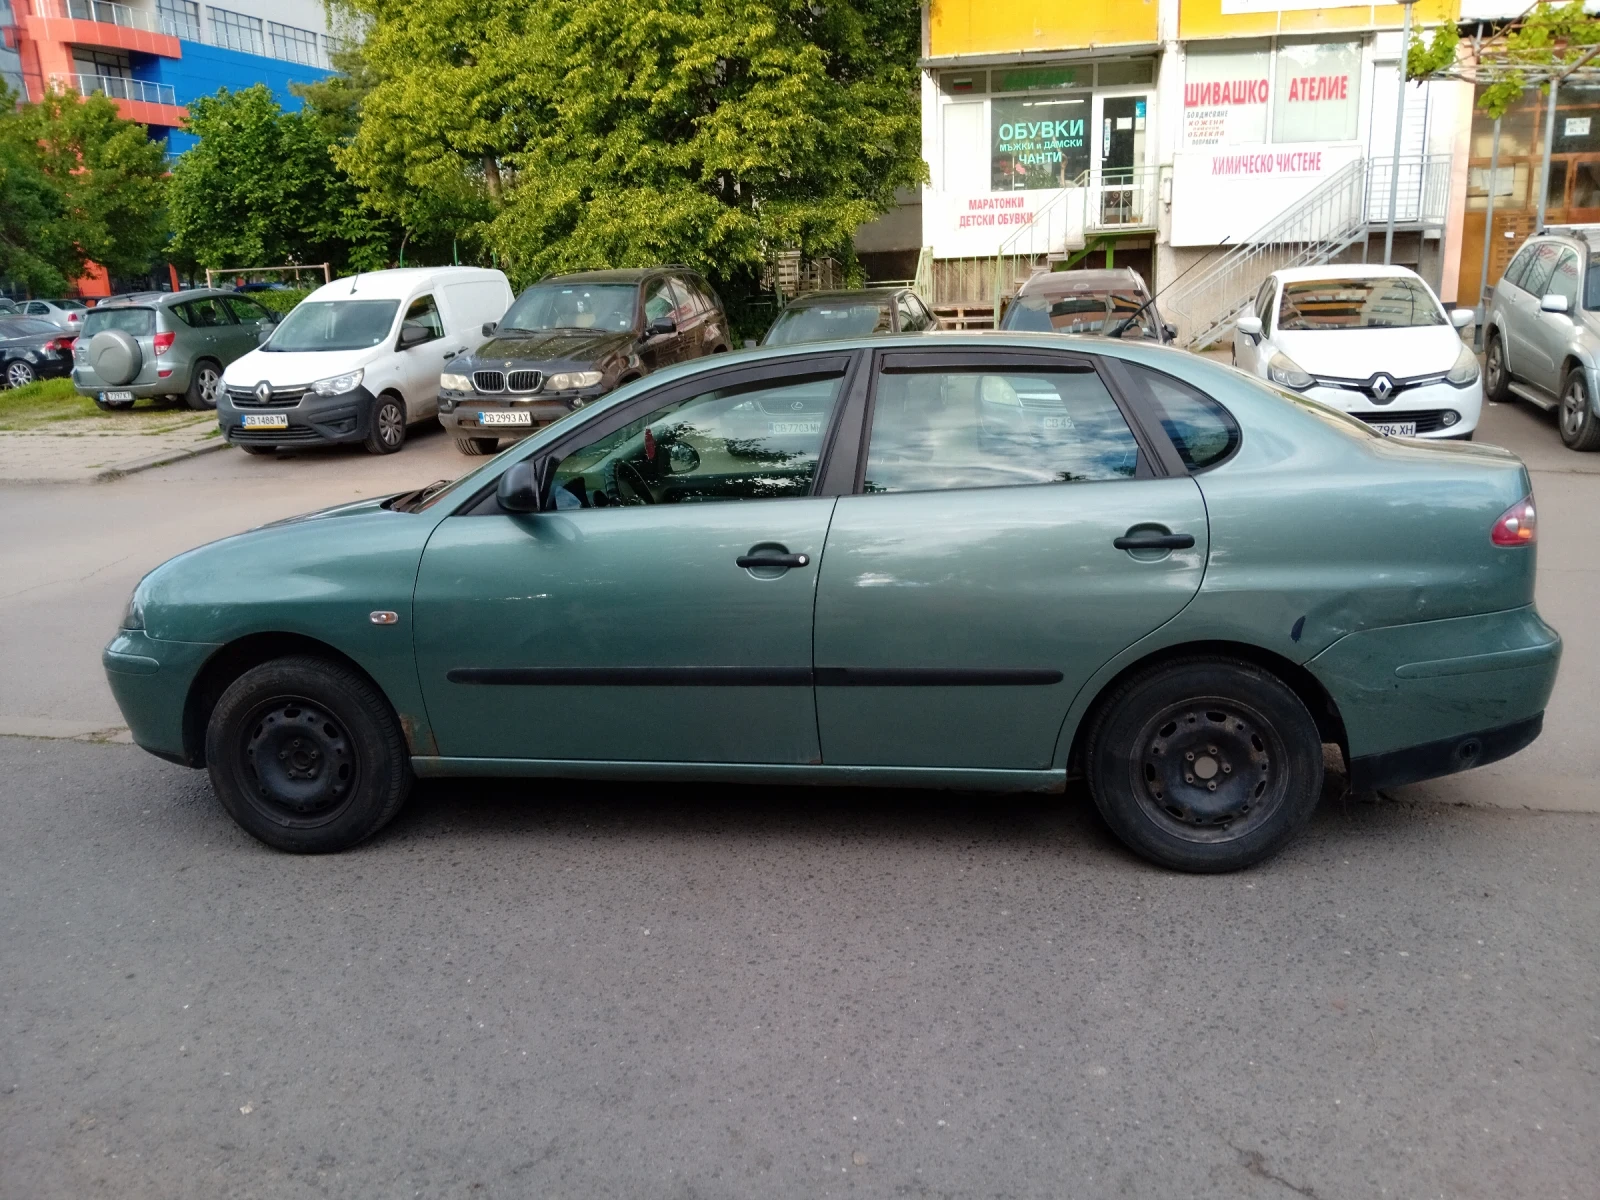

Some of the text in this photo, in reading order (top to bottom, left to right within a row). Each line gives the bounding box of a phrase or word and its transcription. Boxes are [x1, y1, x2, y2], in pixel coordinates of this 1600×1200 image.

[1184, 75, 1348, 107] ШИВАШКО АТЕЛИЕ
[999, 119, 1084, 141] ОБУВКИ
[999, 142, 1034, 152] МЪЖКИ
[1044, 139, 1083, 150] ДАМСКИ
[1019, 151, 1062, 165] ЧАНТИ
[1211, 151, 1322, 175] ХИМИЧЕСКО ЧИСТЕНЕ
[968, 197, 1024, 210] МАРАТОНКИ
[959, 212, 1033, 229] ДЕТСКИ ОБУВКИ
[257, 416, 275, 425] 1488
[484, 413, 530, 423] CB 2993 AX
[787, 423, 809, 433] 7703
[1399, 424, 1414, 435] XH
